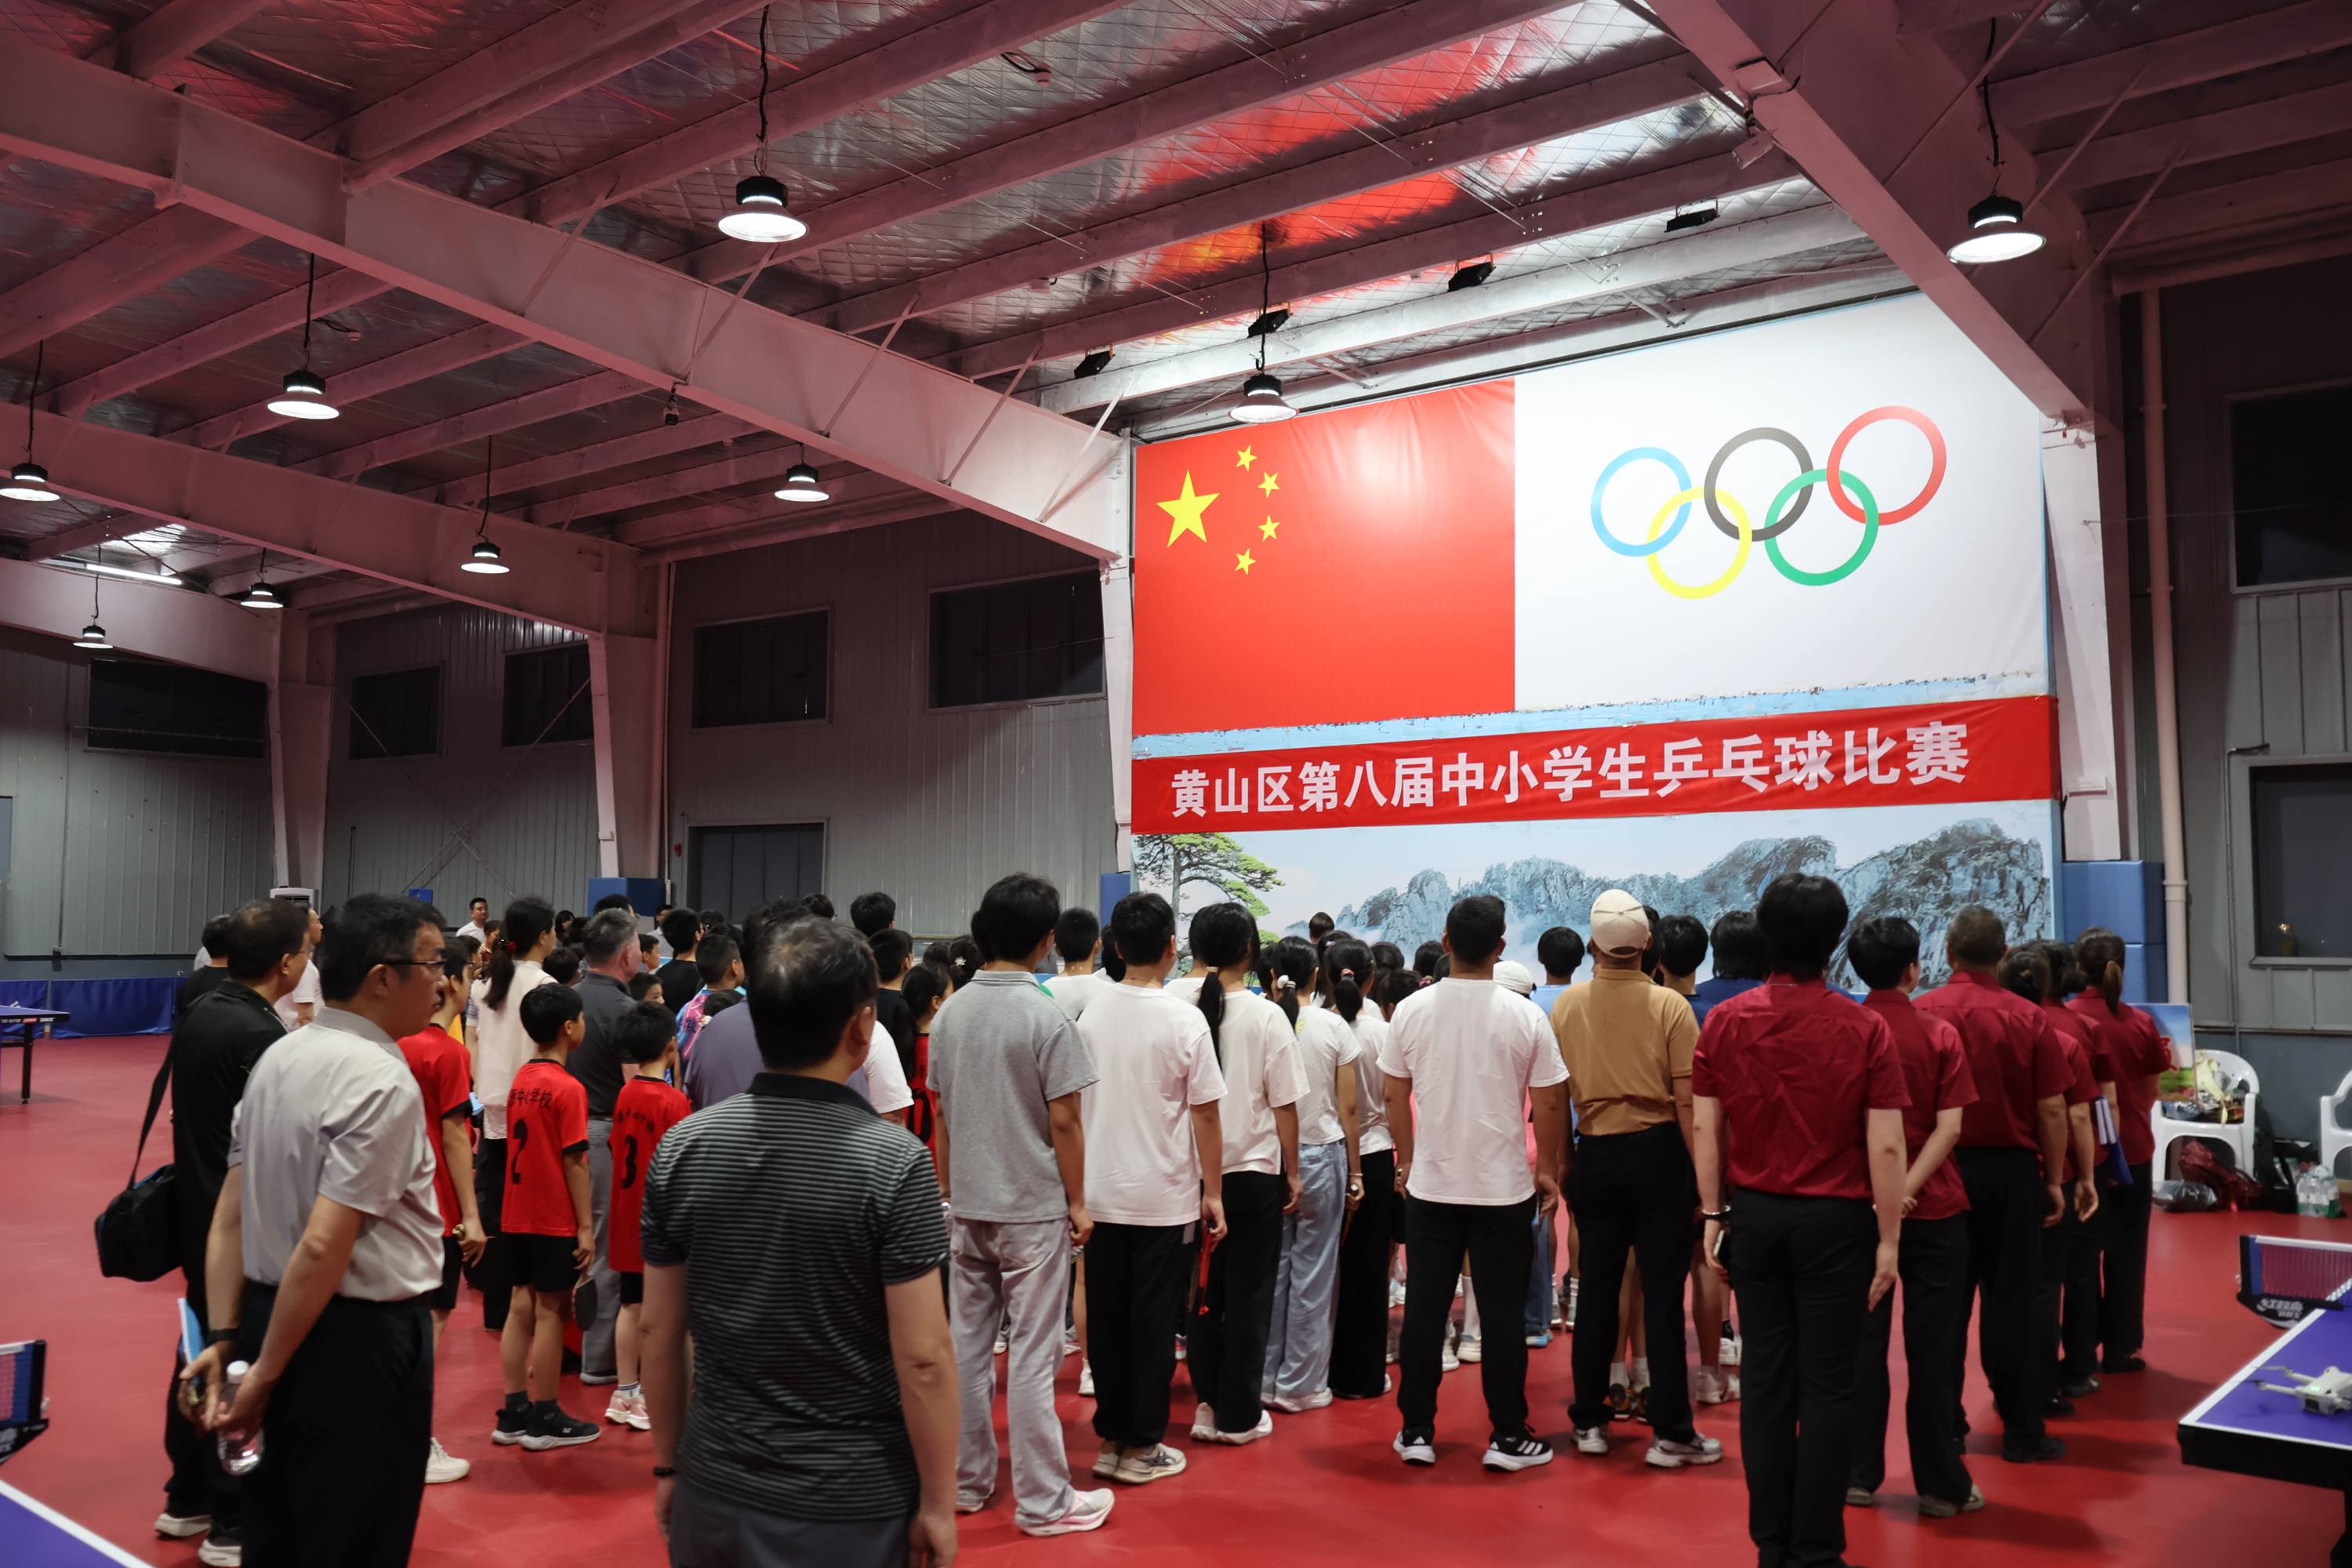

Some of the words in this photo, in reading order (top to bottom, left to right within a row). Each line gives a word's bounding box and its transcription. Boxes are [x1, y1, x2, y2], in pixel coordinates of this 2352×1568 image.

[1171, 720, 1970, 818] 黄山区第八届中小学生乒乓球比赛
[512, 1118, 528, 1185] 2
[622, 1134, 637, 1189] 3
